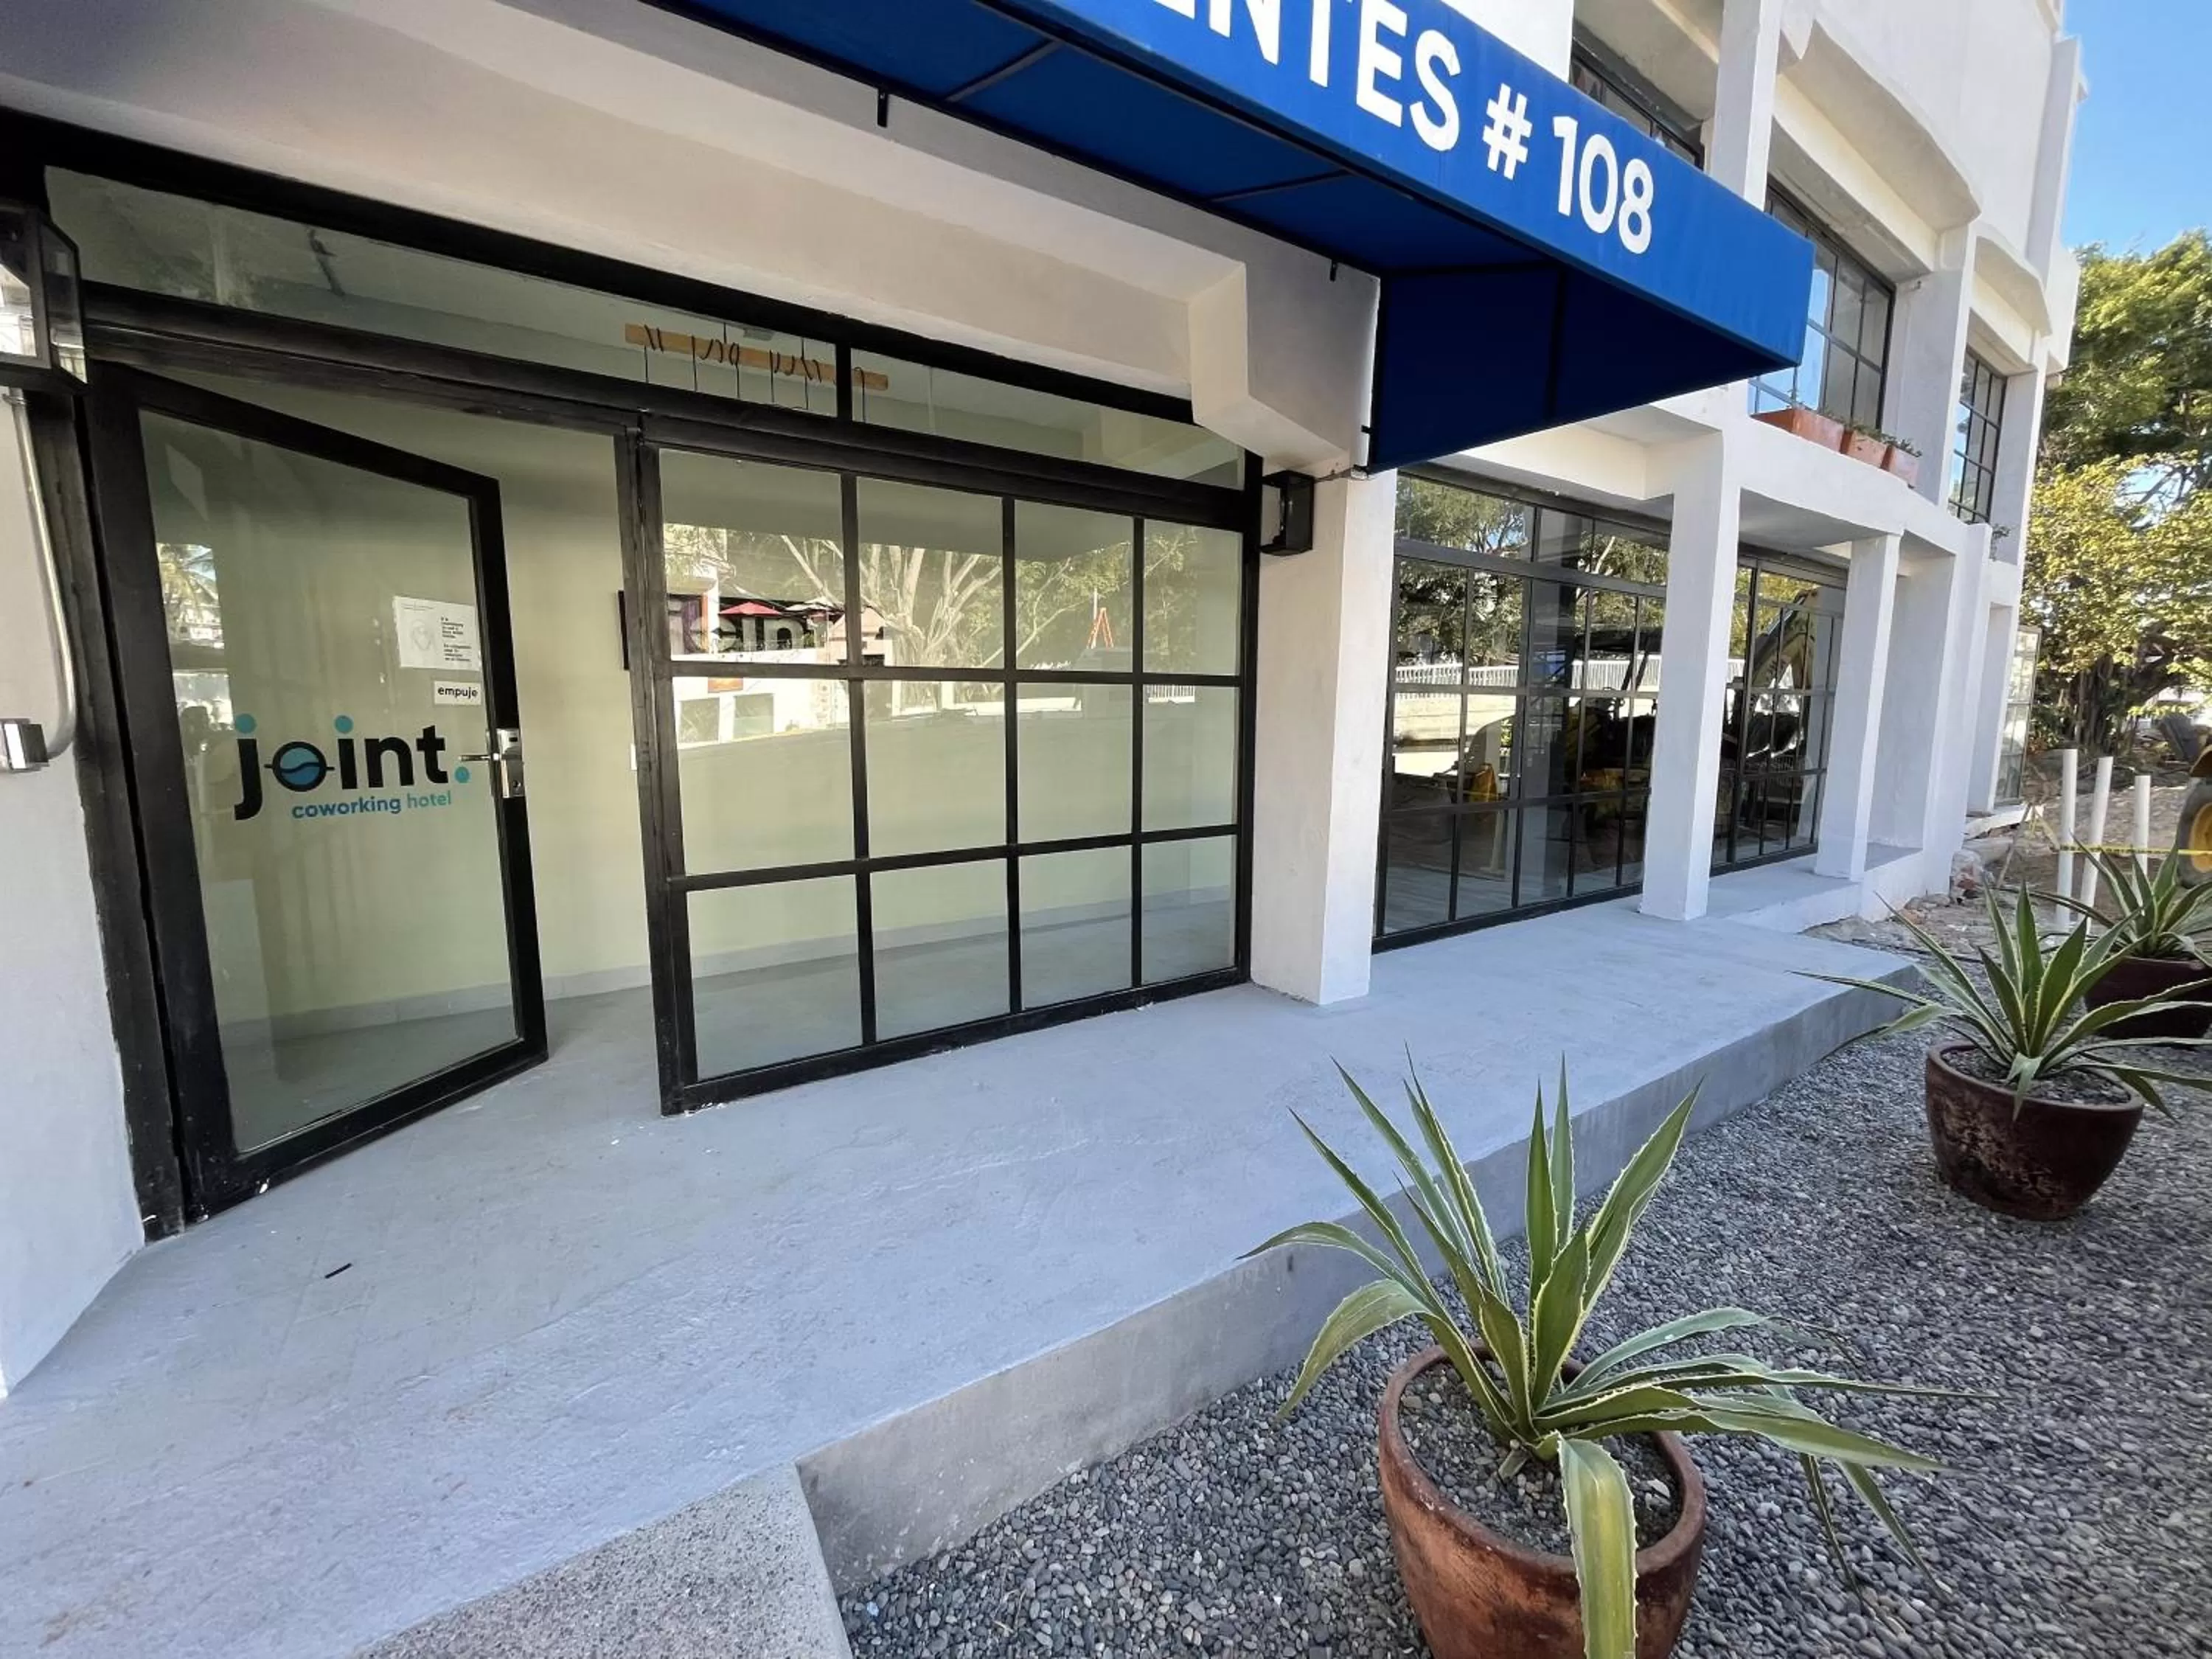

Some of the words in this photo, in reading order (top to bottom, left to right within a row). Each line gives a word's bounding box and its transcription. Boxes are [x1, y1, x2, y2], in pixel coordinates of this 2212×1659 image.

[1155, 0, 1460, 151] TES
[1482, 83, 1533, 180] #
[1553, 116, 1654, 254] 108
[437, 686, 478, 699] empuje
[291, 796, 401, 818] coworking
[406, 790, 451, 809] hotel
